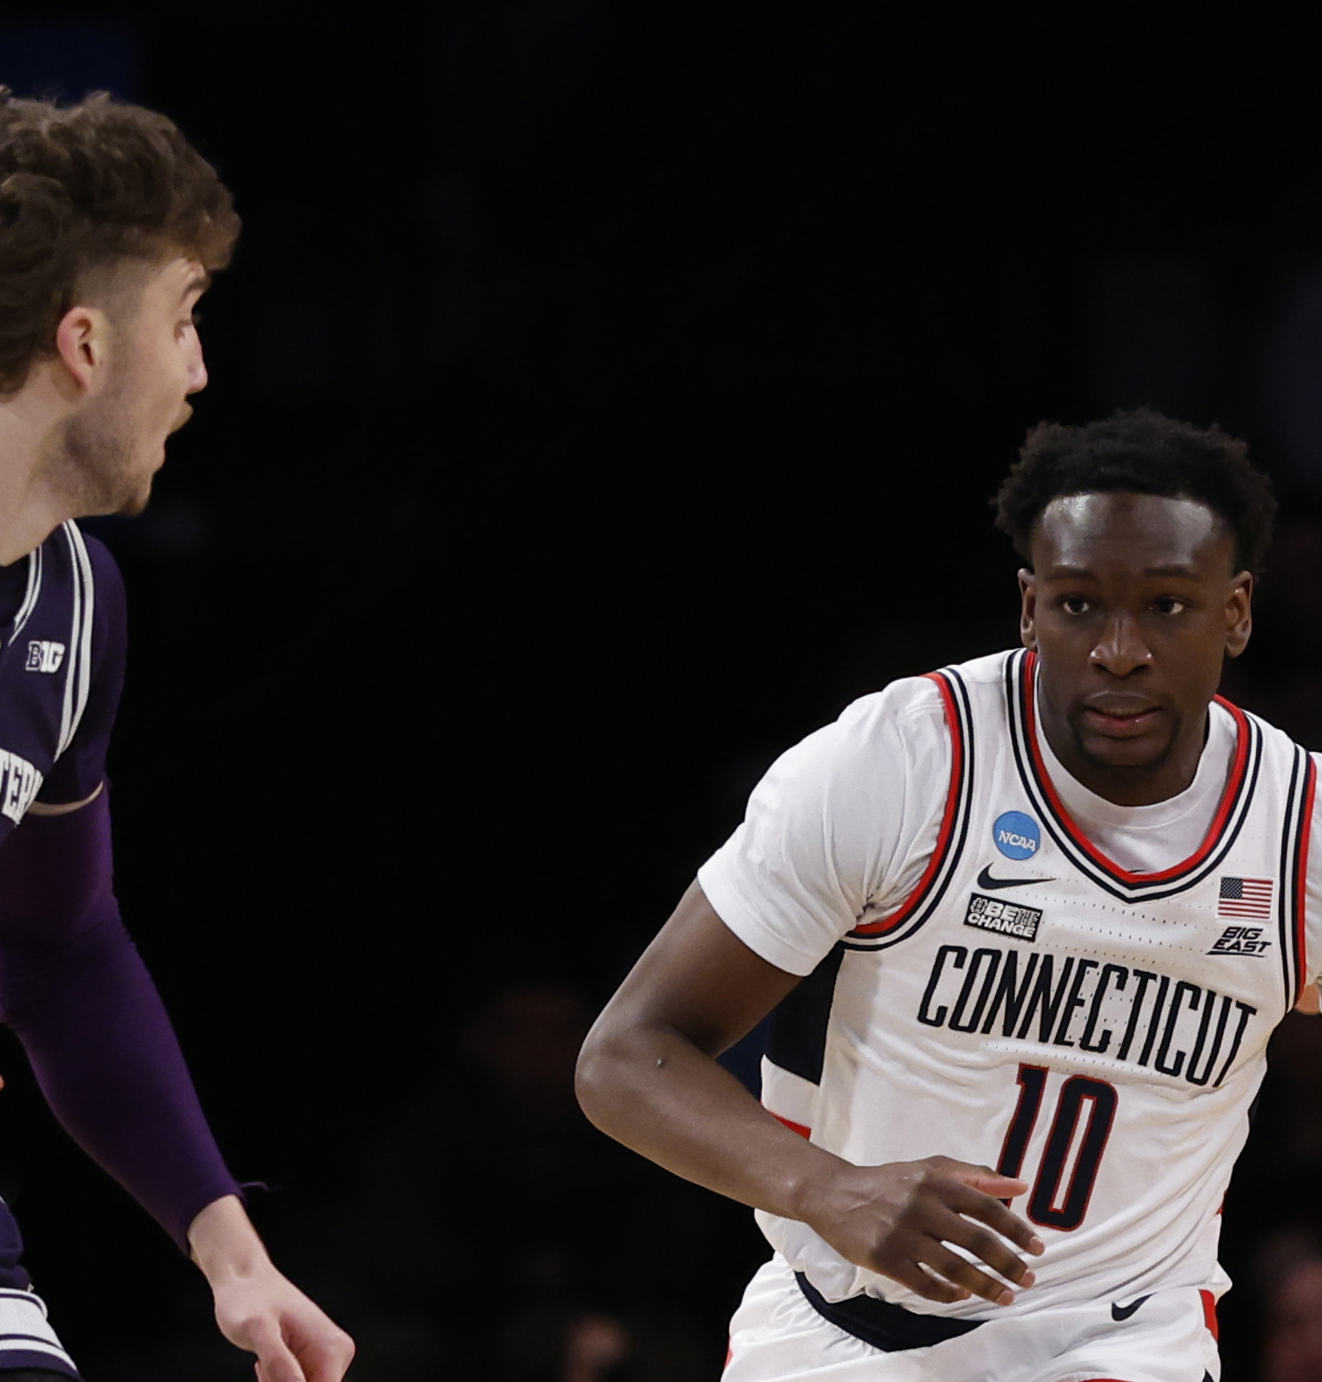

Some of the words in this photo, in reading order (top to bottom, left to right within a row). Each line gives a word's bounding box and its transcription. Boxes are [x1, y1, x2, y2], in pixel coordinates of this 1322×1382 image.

[997, 830, 1037, 852] NCAA
[967, 912, 1036, 938] CHANGE
[1222, 926, 1264, 940] BIG
[1212, 938, 1272, 953] EAST
[917, 945, 1259, 1088] CONNECTICUT
[997, 1064, 1118, 1231] 10
